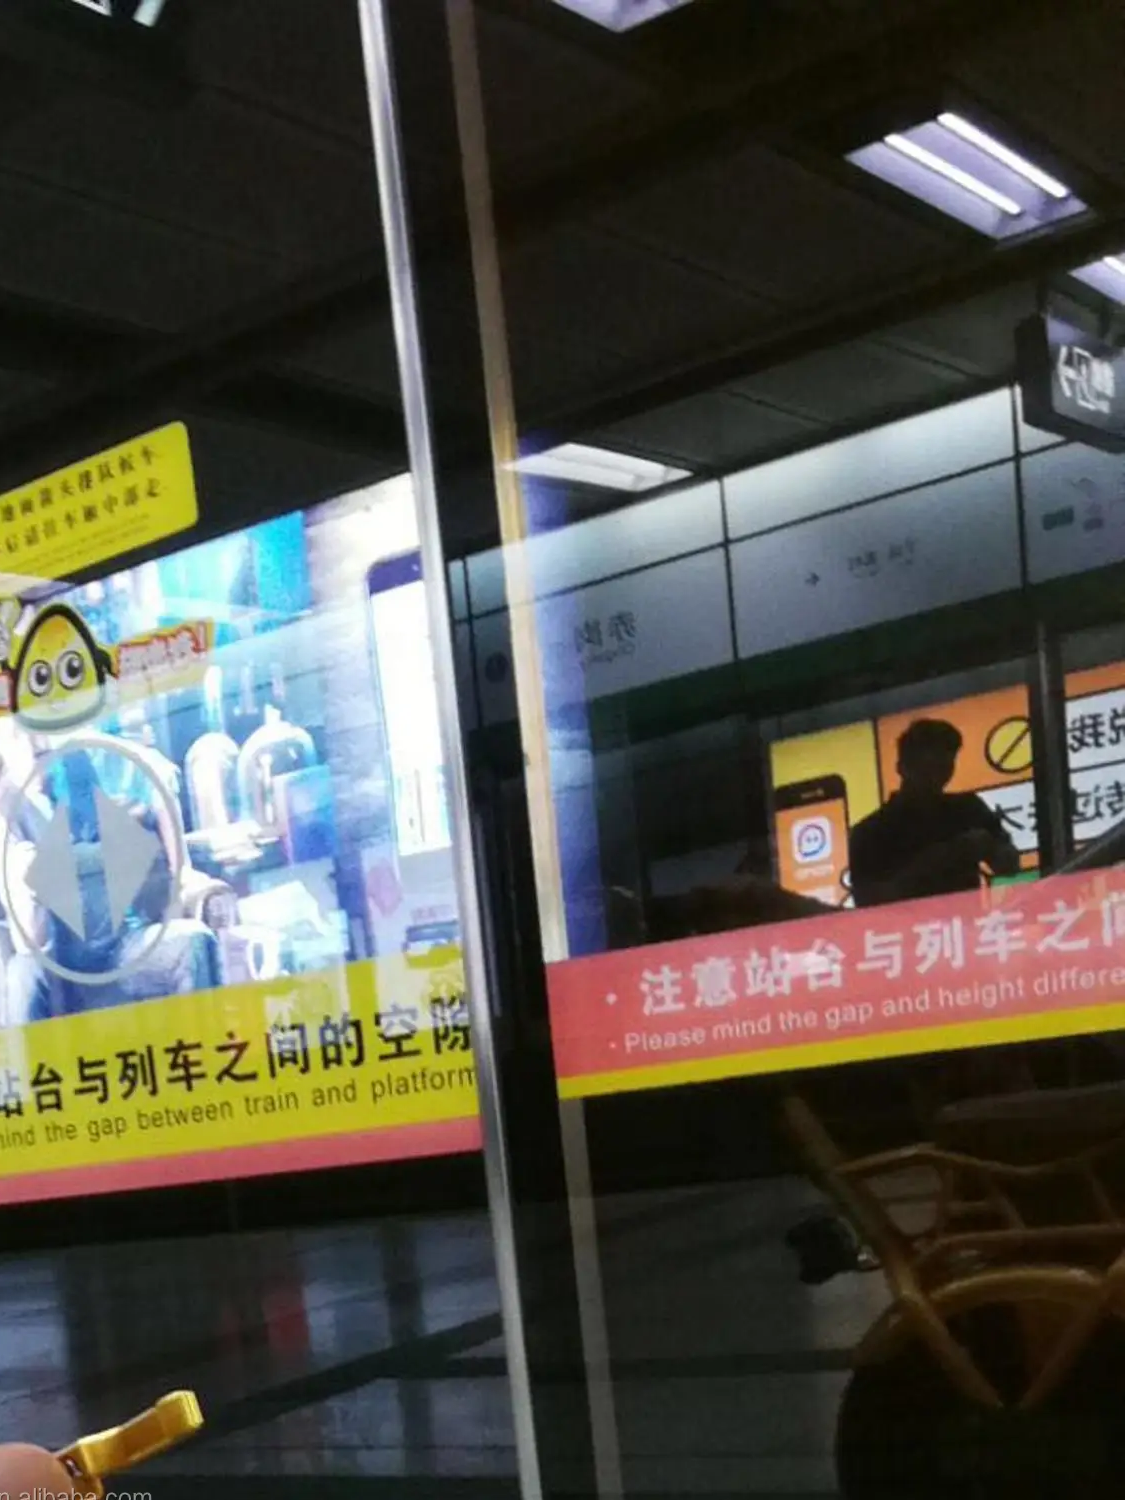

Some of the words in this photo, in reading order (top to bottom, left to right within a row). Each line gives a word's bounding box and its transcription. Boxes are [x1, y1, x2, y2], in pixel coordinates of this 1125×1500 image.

[624, 1026, 706, 1053] Please
[712, 1013, 772, 1041] mind
[778, 1008, 818, 1031] the
[825, 1001, 874, 1030] gap
[882, 988, 930, 1017] and
[938, 979, 1024, 1009] height
[45, 1119, 78, 1143] the
[86, 1114, 127, 1143] gap
[137, 1098, 233, 1130] between
[244, 1088, 300, 1116] train
[312, 1078, 357, 1107] and
